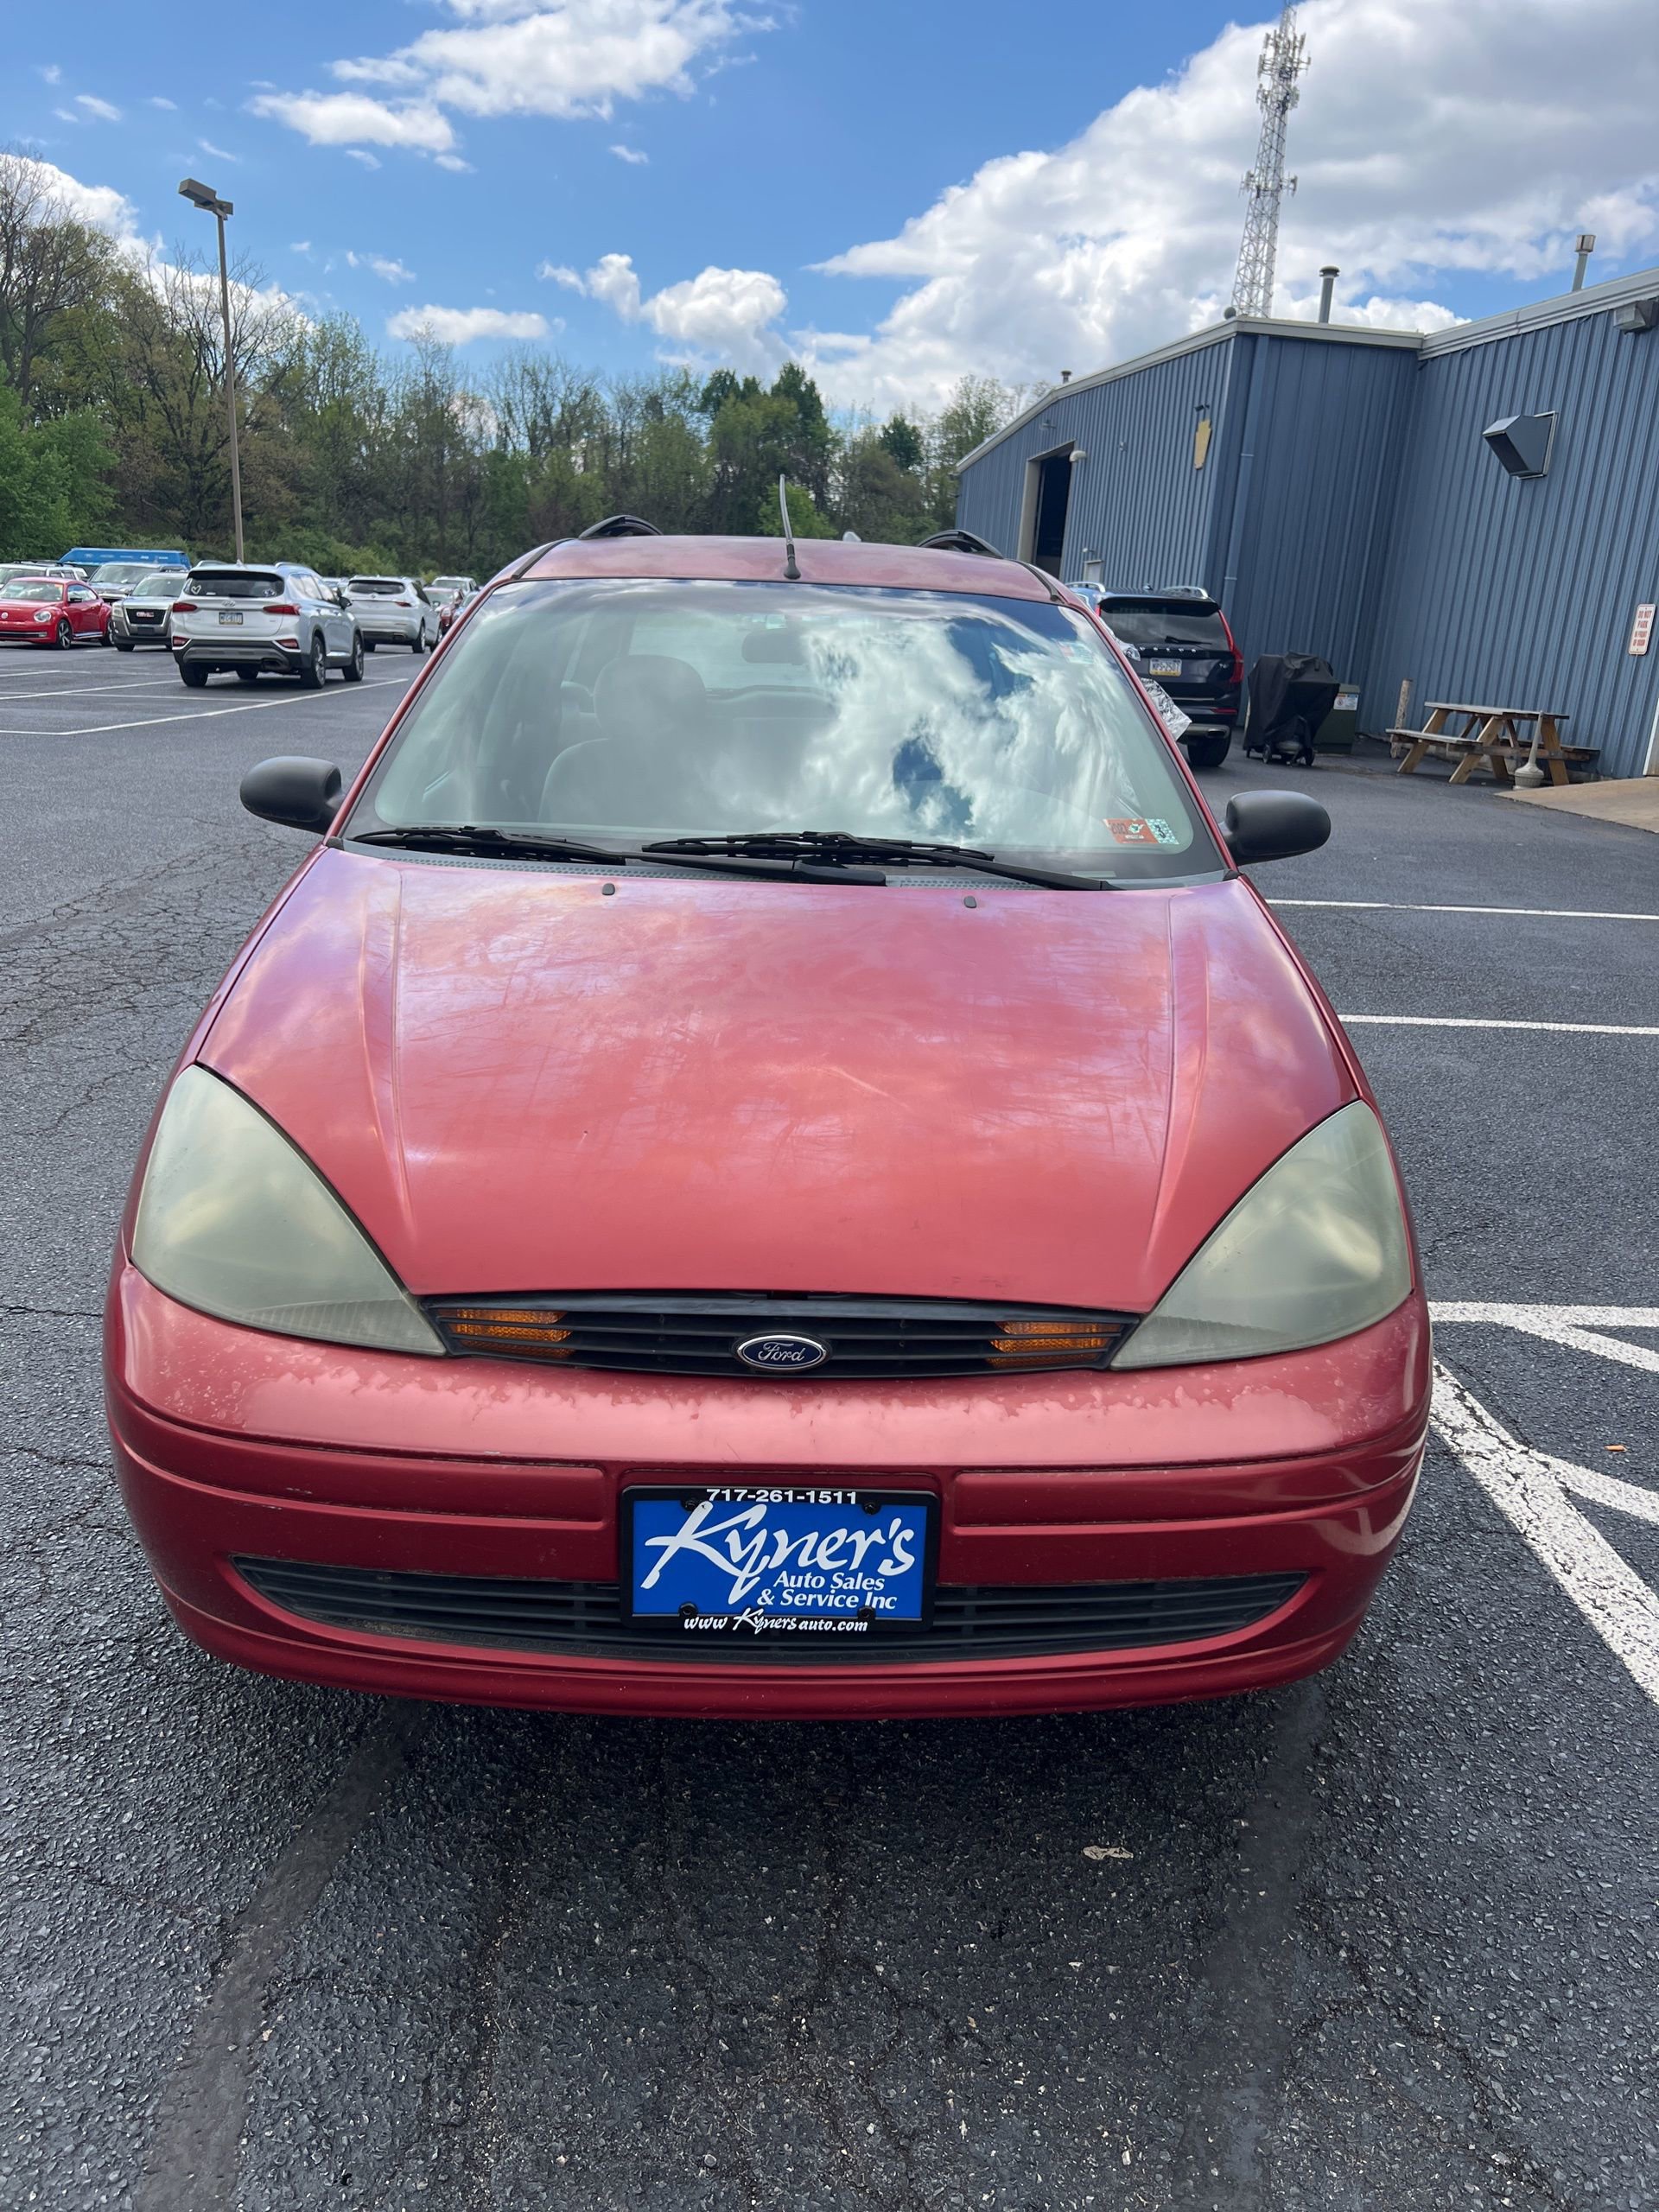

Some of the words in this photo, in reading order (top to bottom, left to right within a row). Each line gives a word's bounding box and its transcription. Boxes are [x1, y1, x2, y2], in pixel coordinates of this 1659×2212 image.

[758, 1341, 805, 1361] Ford
[706, 1488, 857, 1504] 717-261-1511
[640, 1500, 915, 1605] Kyner's
[772, 1570, 825, 1589] Auto
[830, 1572, 886, 1591] Sales
[756, 1588, 775, 1606] &
[779, 1588, 860, 1608] Service
[864, 1591, 898, 1610] Inc
[683, 1616, 728, 1630] www
